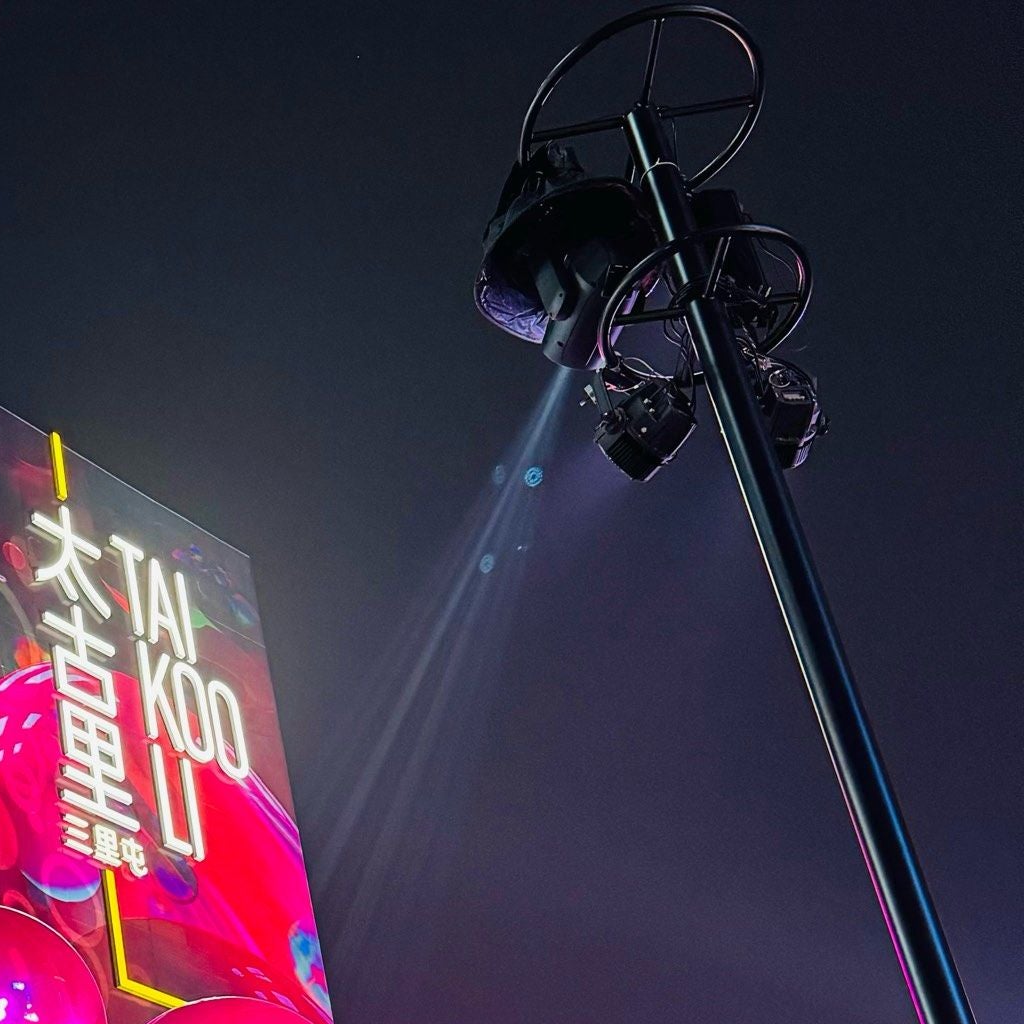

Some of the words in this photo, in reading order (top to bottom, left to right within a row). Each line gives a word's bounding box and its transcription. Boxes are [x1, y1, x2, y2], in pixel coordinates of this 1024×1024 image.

[108, 533, 197, 665] TAI
[31, 505, 141, 833] 太古里
[136, 640, 250, 781] KOO
[61, 813, 149, 878] 三里屯
[150, 743, 206, 862] LI
